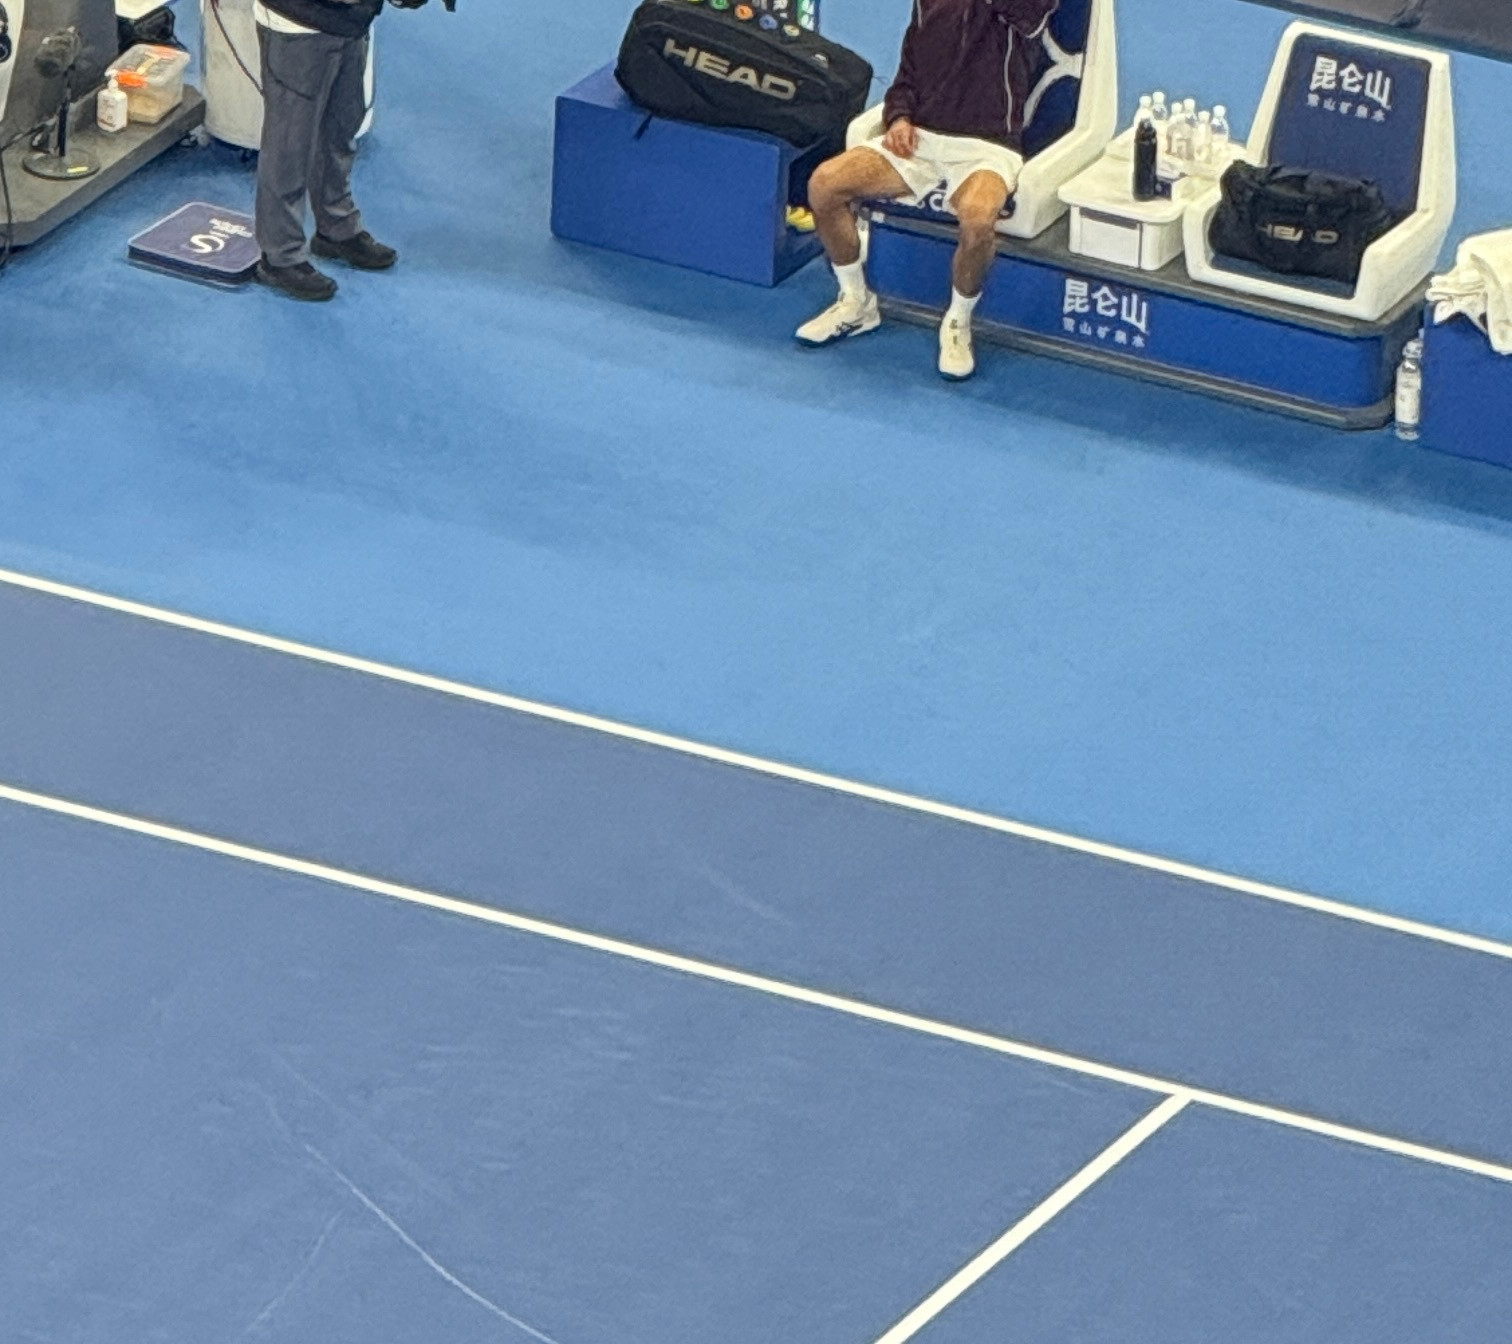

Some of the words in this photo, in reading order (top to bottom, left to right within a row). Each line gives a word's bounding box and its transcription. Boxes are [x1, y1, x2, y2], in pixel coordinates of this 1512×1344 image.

[663, 38, 797, 100] HEAD
[1309, 55, 1392, 111] 昆仑山
[1063, 278, 1149, 335] 昆仑山
